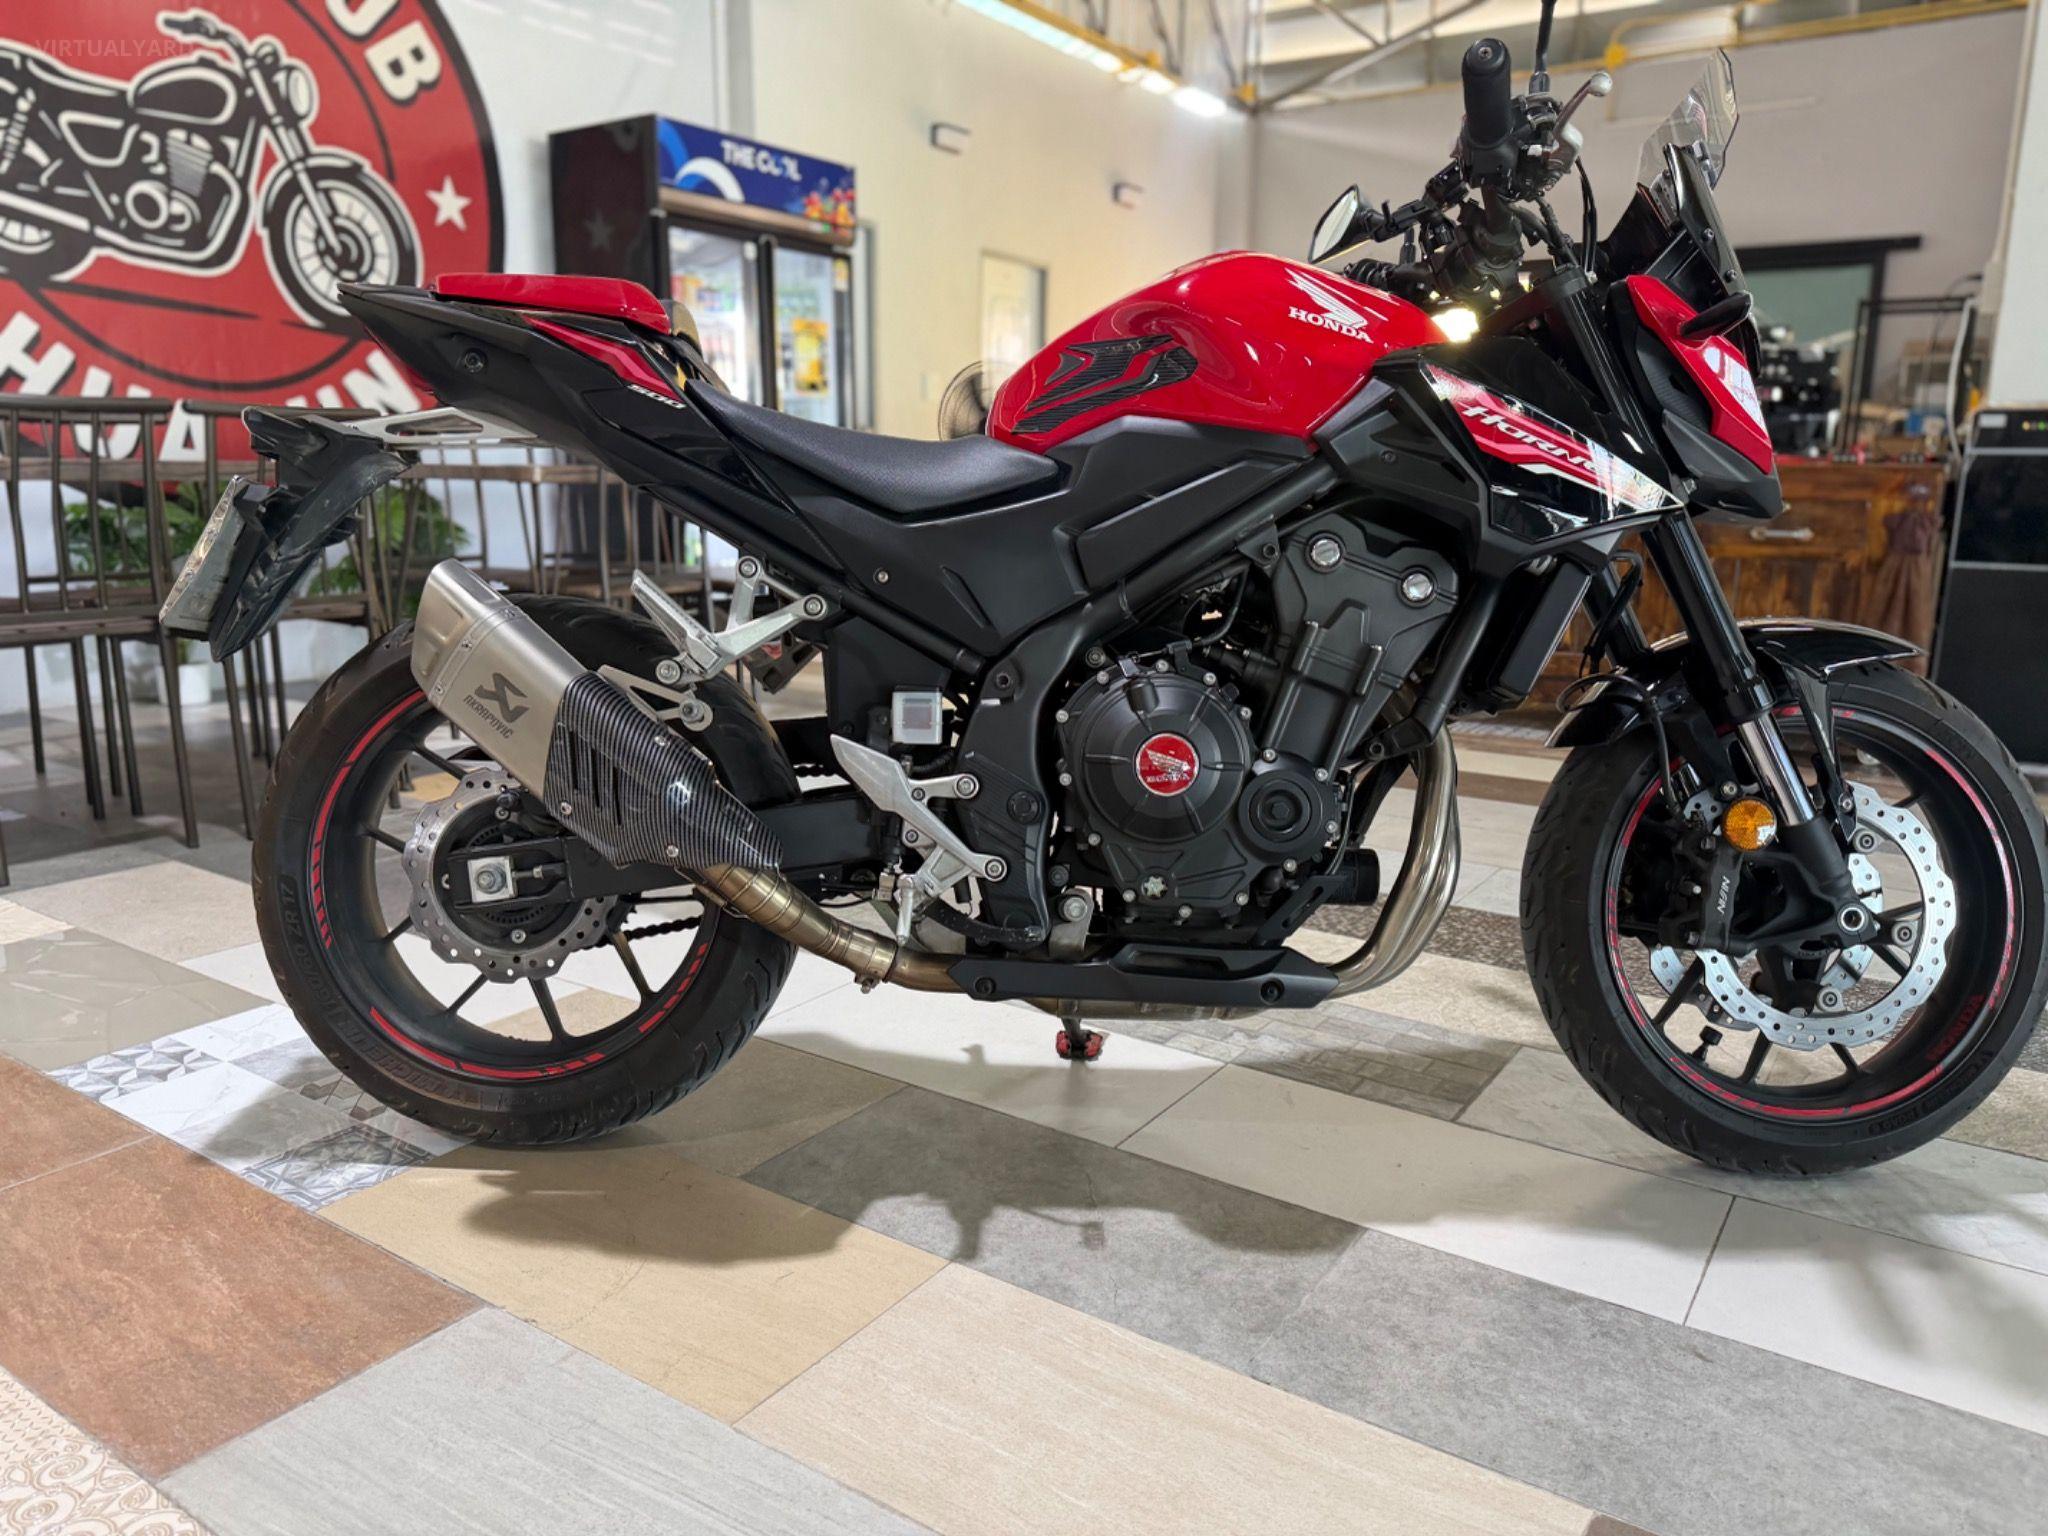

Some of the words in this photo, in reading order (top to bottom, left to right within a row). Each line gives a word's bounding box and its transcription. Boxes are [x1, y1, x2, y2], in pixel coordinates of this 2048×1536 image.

[721, 140, 756, 170] THE
[1288, 306, 1374, 344] HONDA
[627, 384, 686, 409] 500
[280, 881, 294, 905] 17
